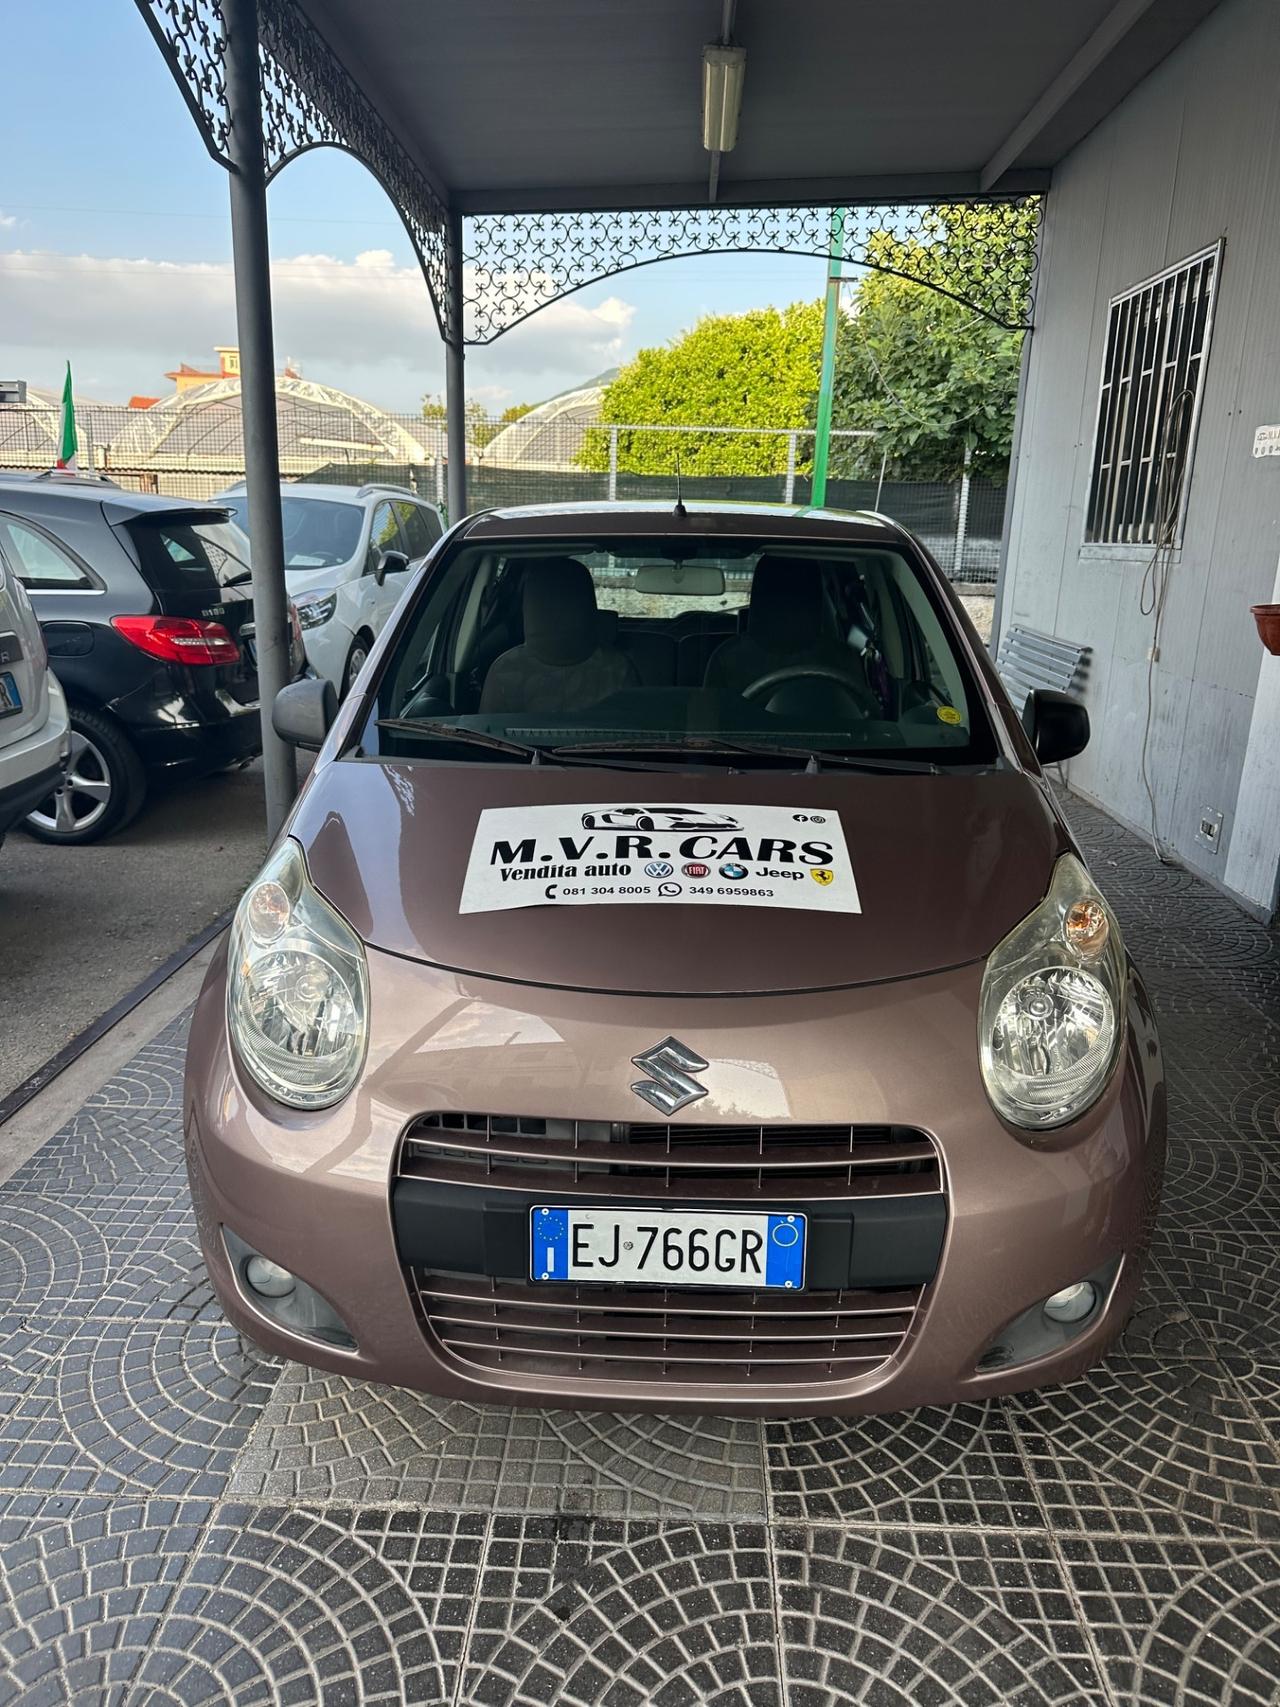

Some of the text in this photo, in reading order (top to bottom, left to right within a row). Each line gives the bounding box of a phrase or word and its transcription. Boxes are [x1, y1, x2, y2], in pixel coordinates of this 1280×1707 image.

[500, 862, 632, 882] Vendita auto
[688, 866, 705, 875] FIAT
[755, 867, 805, 881] Jeep
[562, 886, 651, 896] 081 304 8005
[689, 886, 774, 897] 349 6959863
